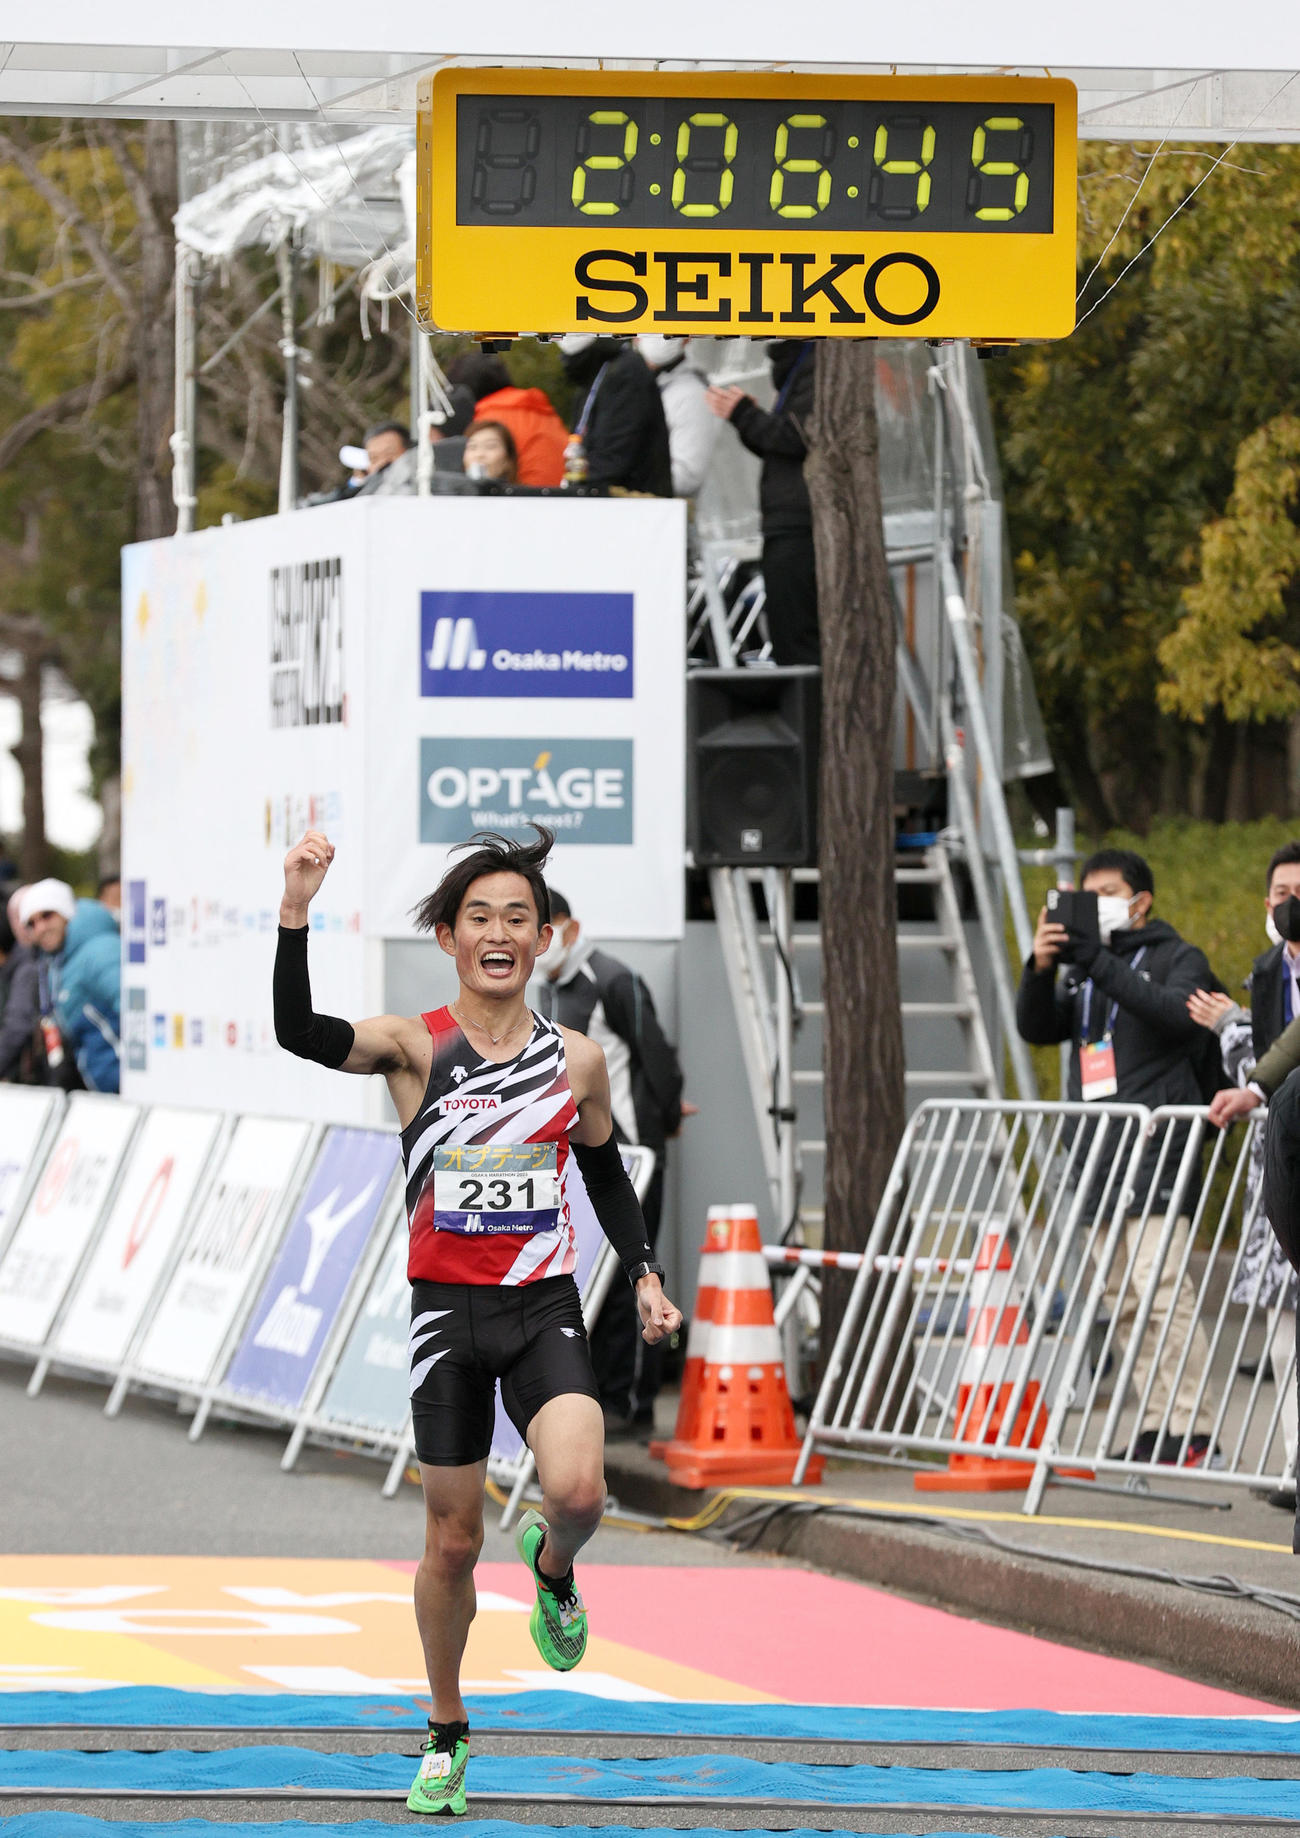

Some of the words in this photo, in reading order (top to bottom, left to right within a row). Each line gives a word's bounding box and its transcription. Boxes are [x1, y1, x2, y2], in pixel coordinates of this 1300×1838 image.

[571, 110, 1030, 221] 2:06:45
[575, 249, 940, 325] SEIKO
[492, 649, 560, 671] Osaka
[562, 650, 628, 671] Metro
[427, 752, 625, 808] OPTAGE
[471, 811, 530, 829] What's
[443, 1098, 497, 1111] TOYOTA
[443, 1145, 550, 1170] オプテージ
[458, 1178, 535, 1210] 231
[487, 1224, 511, 1232] Osaka
